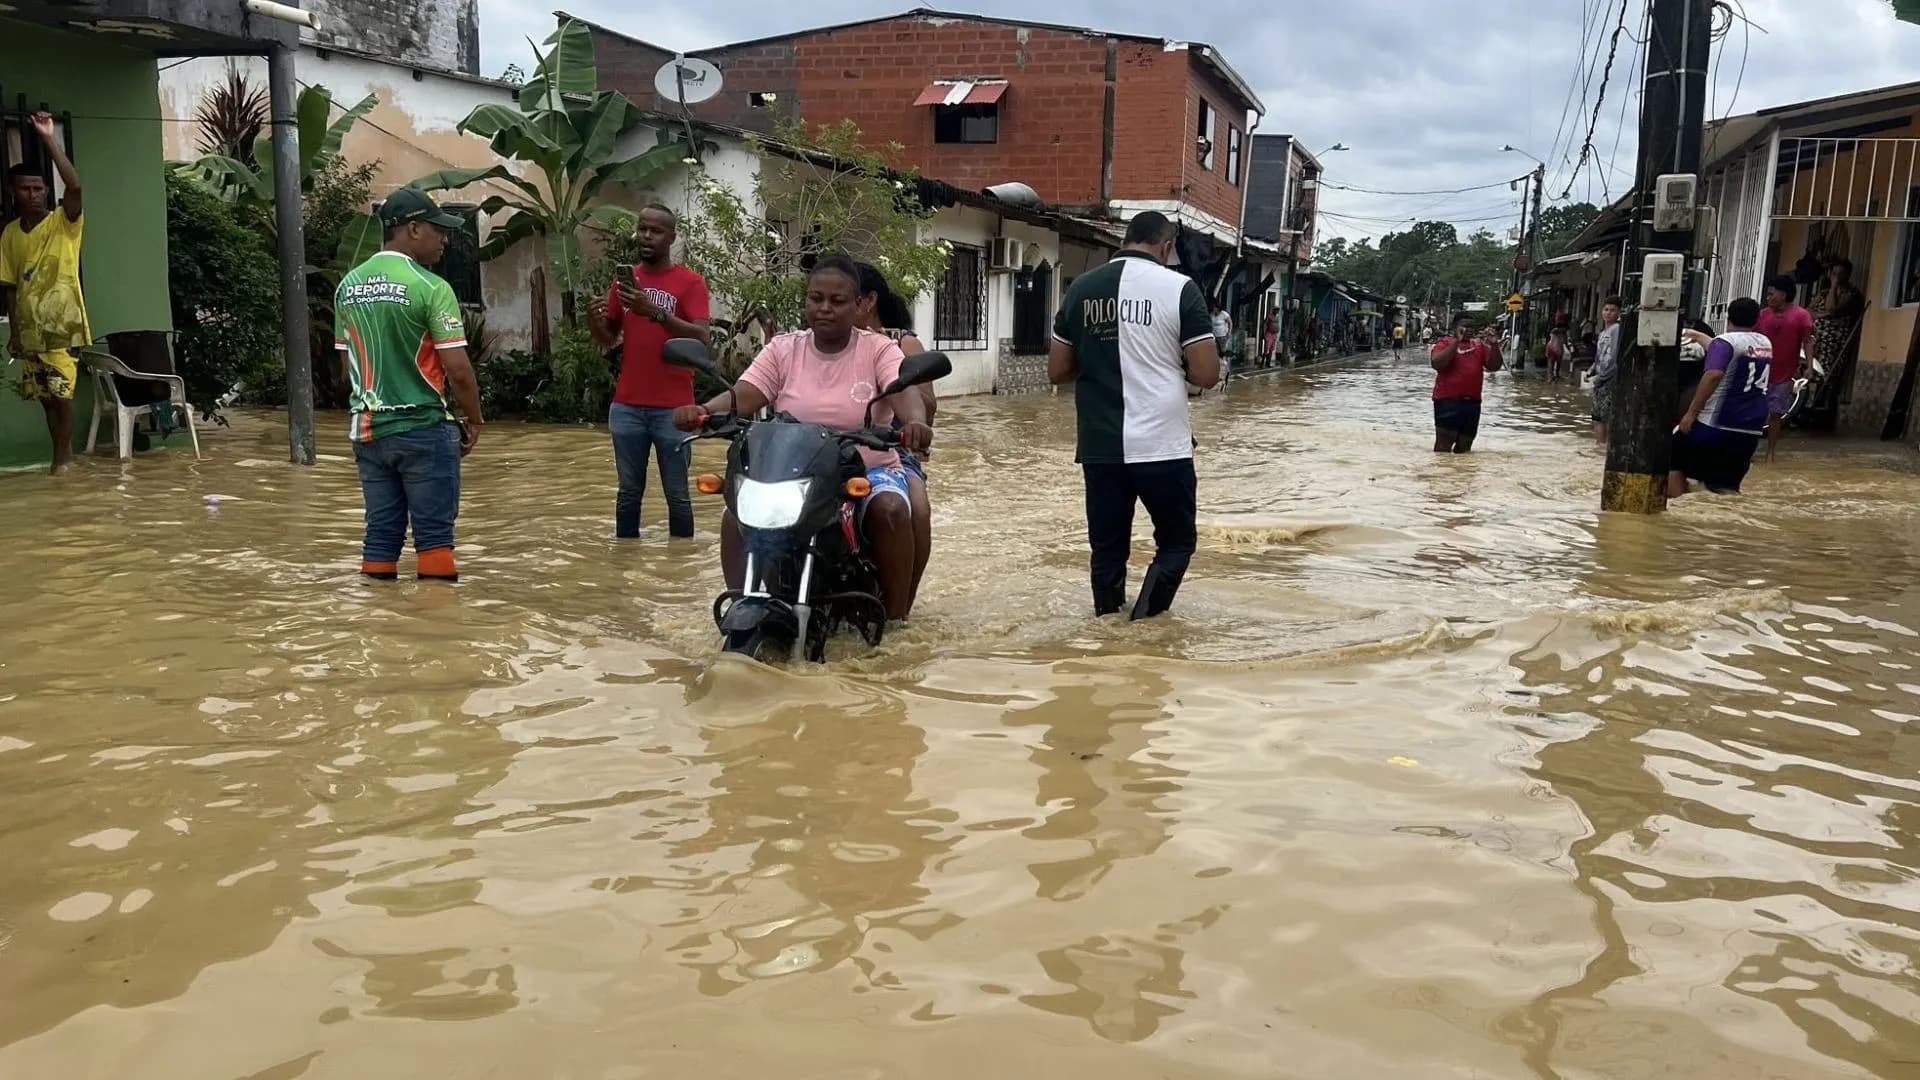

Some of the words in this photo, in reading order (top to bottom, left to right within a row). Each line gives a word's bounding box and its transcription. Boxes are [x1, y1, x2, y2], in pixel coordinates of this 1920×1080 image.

[346, 283, 408, 297] DEPORTE
[1083, 297, 1117, 328] POLO
[1120, 298, 1152, 326] CLUB
[1743, 361, 1771, 396] 14
